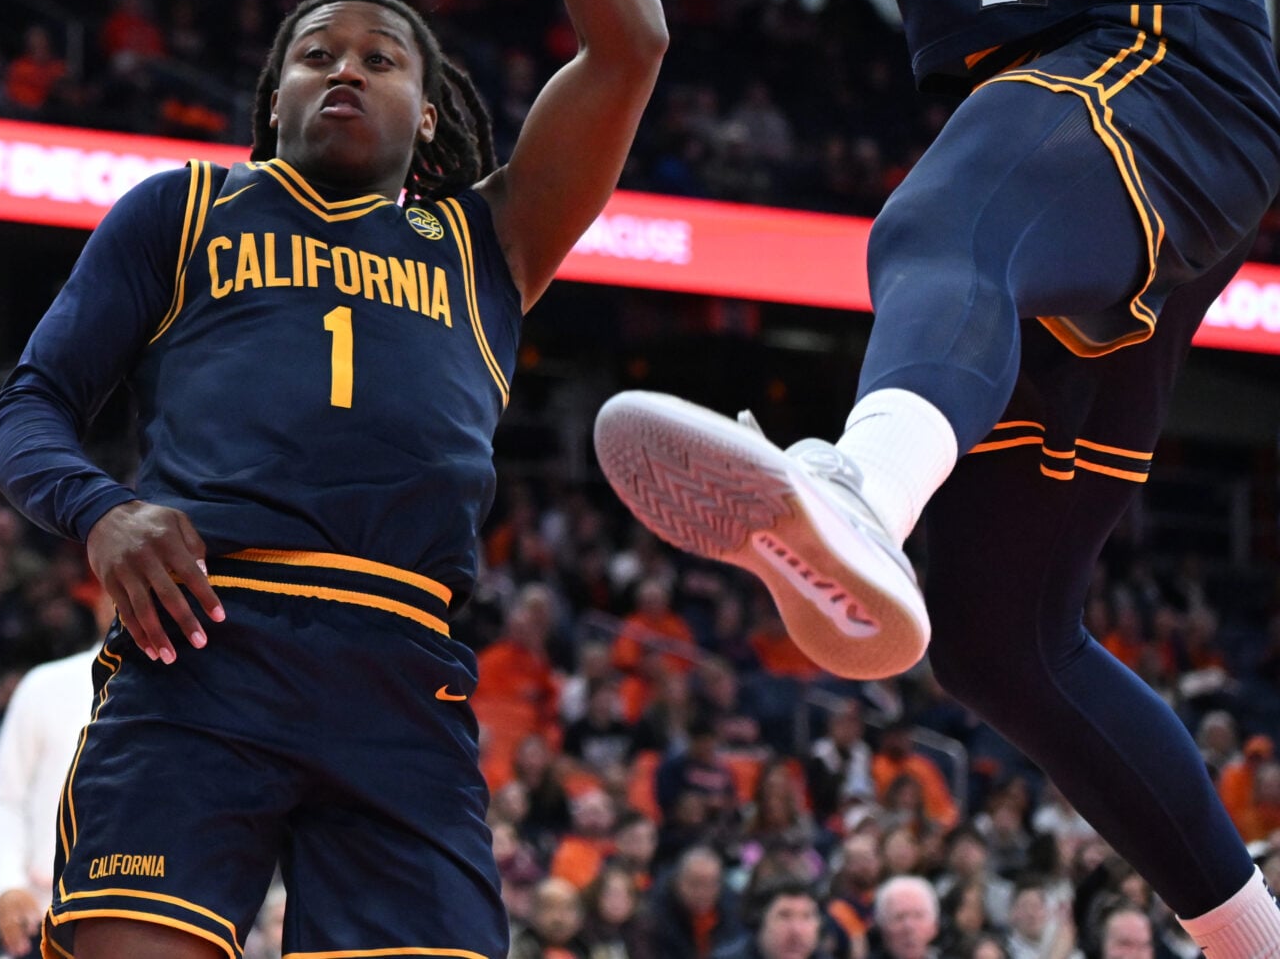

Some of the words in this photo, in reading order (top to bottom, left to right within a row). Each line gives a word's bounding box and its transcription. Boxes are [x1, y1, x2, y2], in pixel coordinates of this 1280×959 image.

[410, 217, 440, 231] ACC
[207, 232, 453, 328] CALIFORNIA
[323, 305, 354, 409] 1
[88, 853, 165, 880] CALIFORNIA
